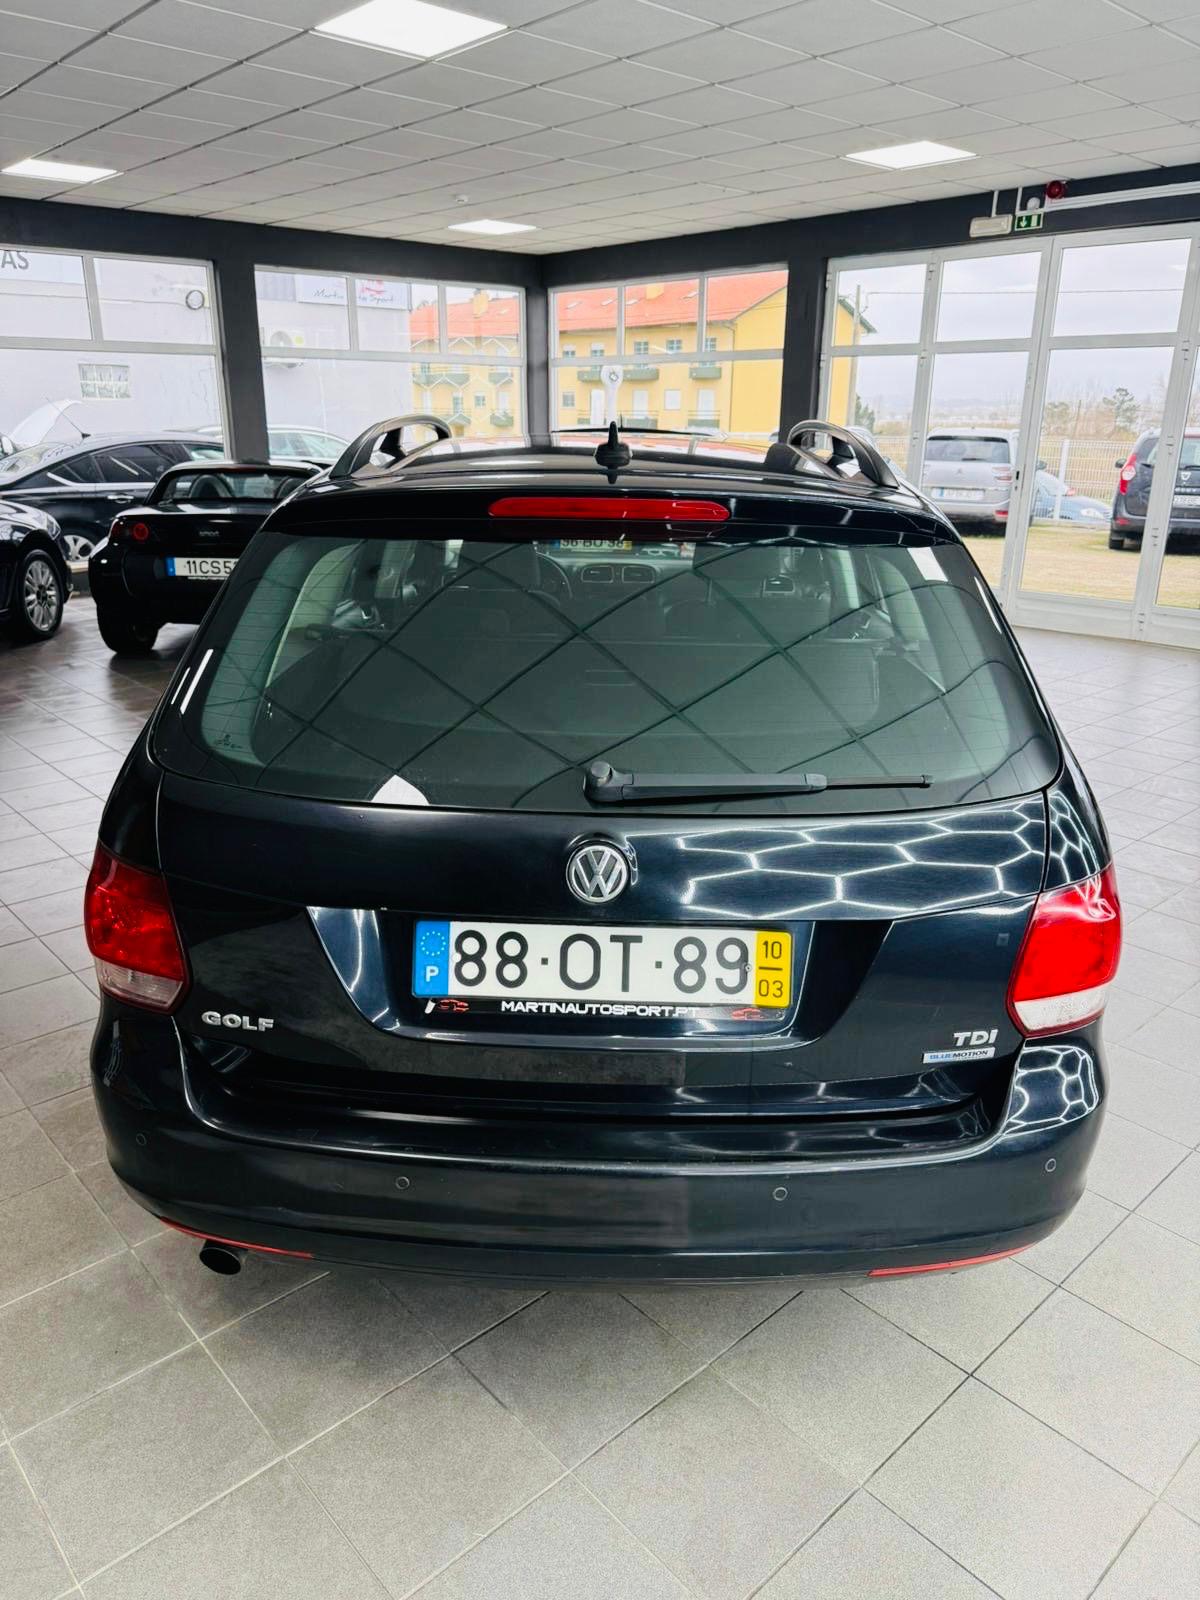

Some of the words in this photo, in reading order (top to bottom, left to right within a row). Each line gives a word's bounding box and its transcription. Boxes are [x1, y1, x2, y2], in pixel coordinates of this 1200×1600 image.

[186, 560, 238, 575] 11CS5
[762, 940, 783, 960] 10
[425, 966, 439, 982] P
[758, 980, 784, 998] 03
[501, 1000, 700, 1018] MARTINAUTOSPORT.PT
[201, 1011, 274, 1032] GOLF
[953, 1029, 998, 1047] TDI
[929, 1050, 988, 1060] BLUEMOTION
